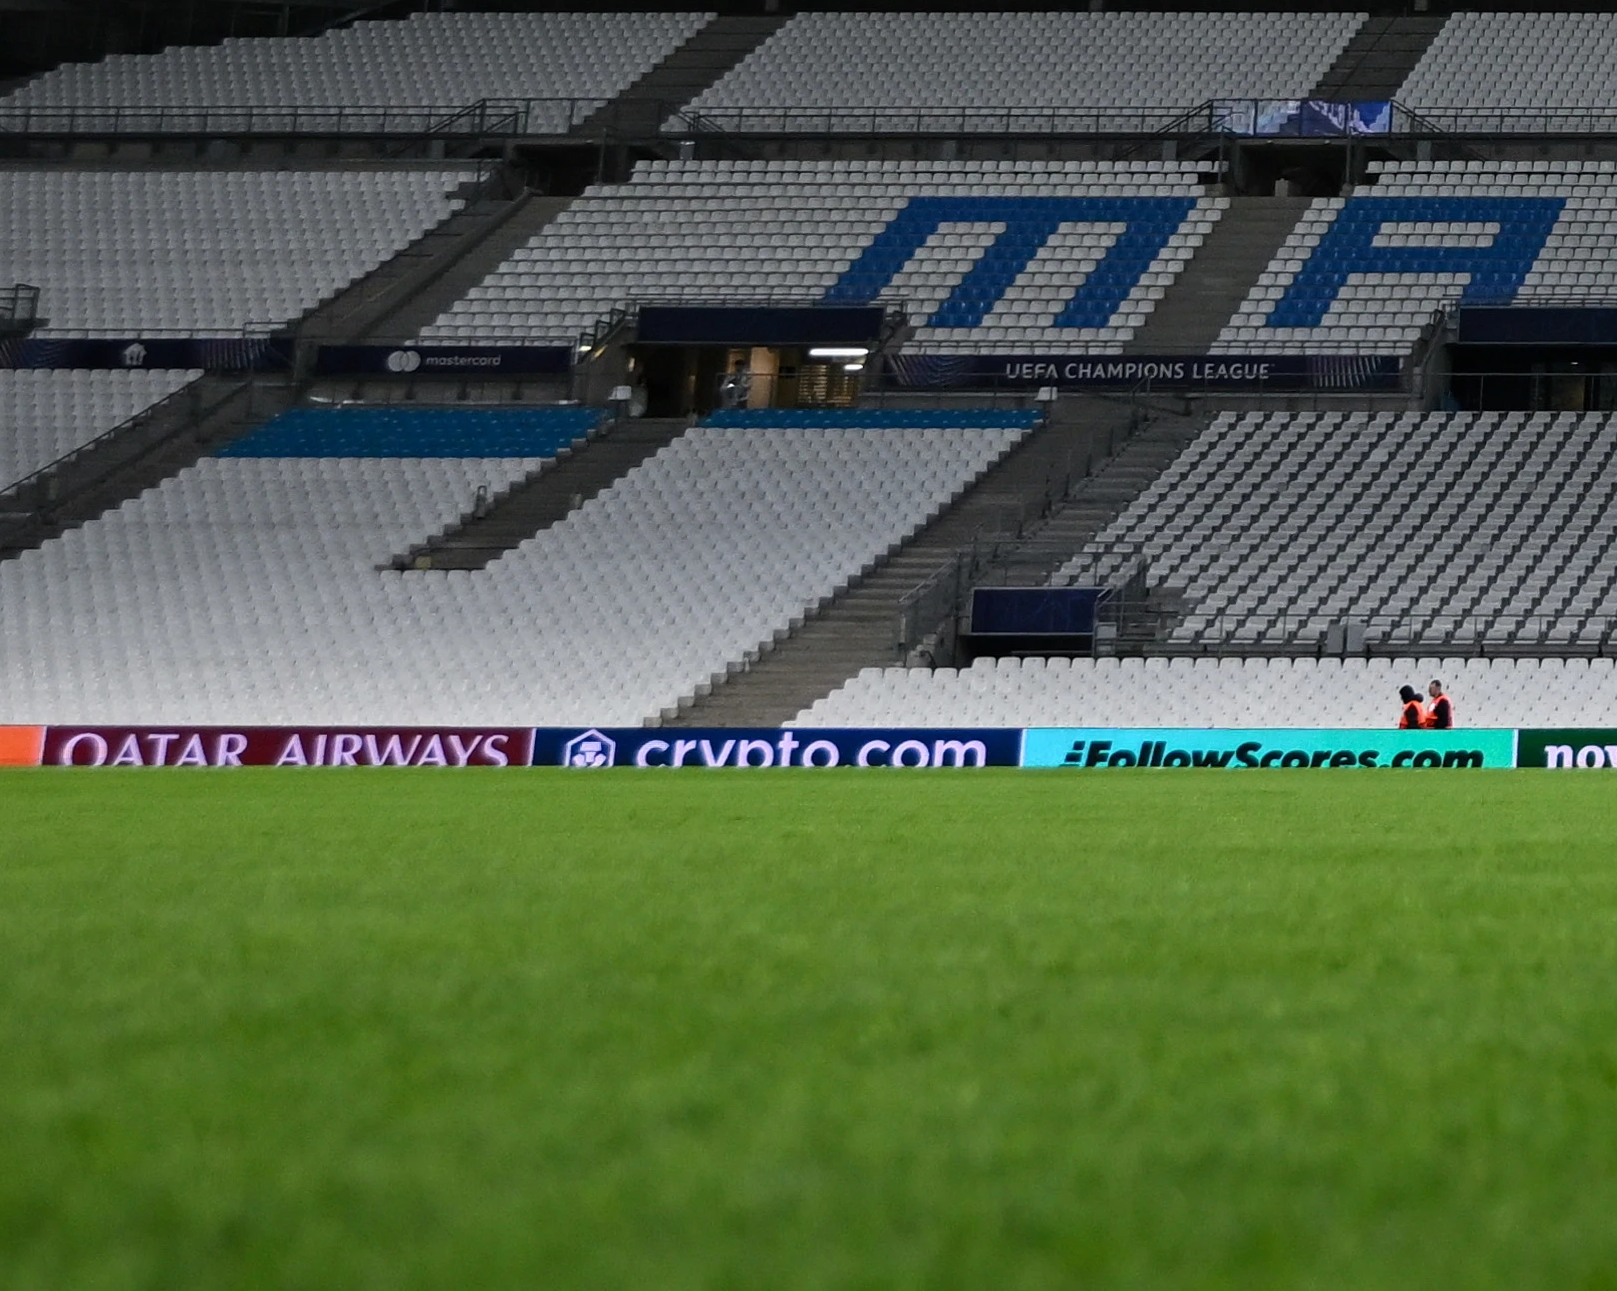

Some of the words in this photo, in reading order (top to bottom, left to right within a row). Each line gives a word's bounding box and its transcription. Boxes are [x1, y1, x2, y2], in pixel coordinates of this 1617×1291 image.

[426, 355, 502, 367] mastercard
[1005, 363, 1059, 379] UEFA
[1064, 363, 1185, 380] CHAMPIONS
[1192, 363, 1270, 379] LEAGUE
[61, 733, 248, 766] QATAR
[275, 734, 510, 766] AIRWAYS
[636, 731, 988, 768] crypto.com
